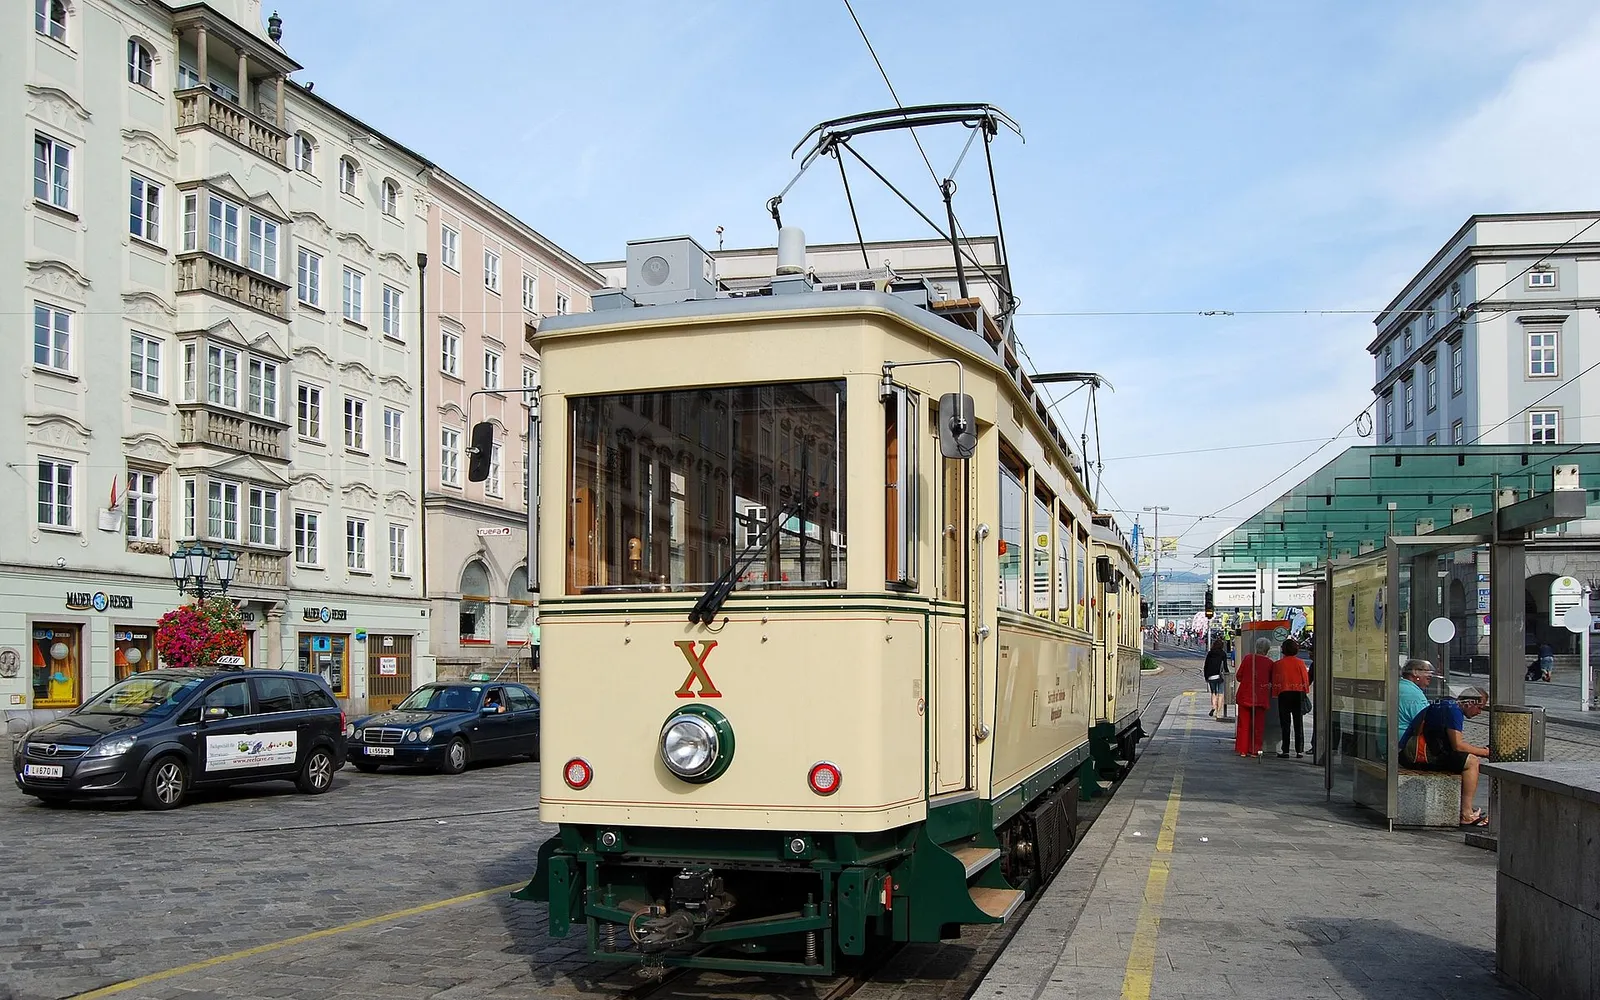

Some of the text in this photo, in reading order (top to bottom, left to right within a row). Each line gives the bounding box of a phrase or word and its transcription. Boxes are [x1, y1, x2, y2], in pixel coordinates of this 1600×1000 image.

[66, 592, 133, 609] MADER REISEN
[303, 607, 320, 618] MADER
[218, 656, 240, 664] TAXI
[674, 640, 722, 698] X
